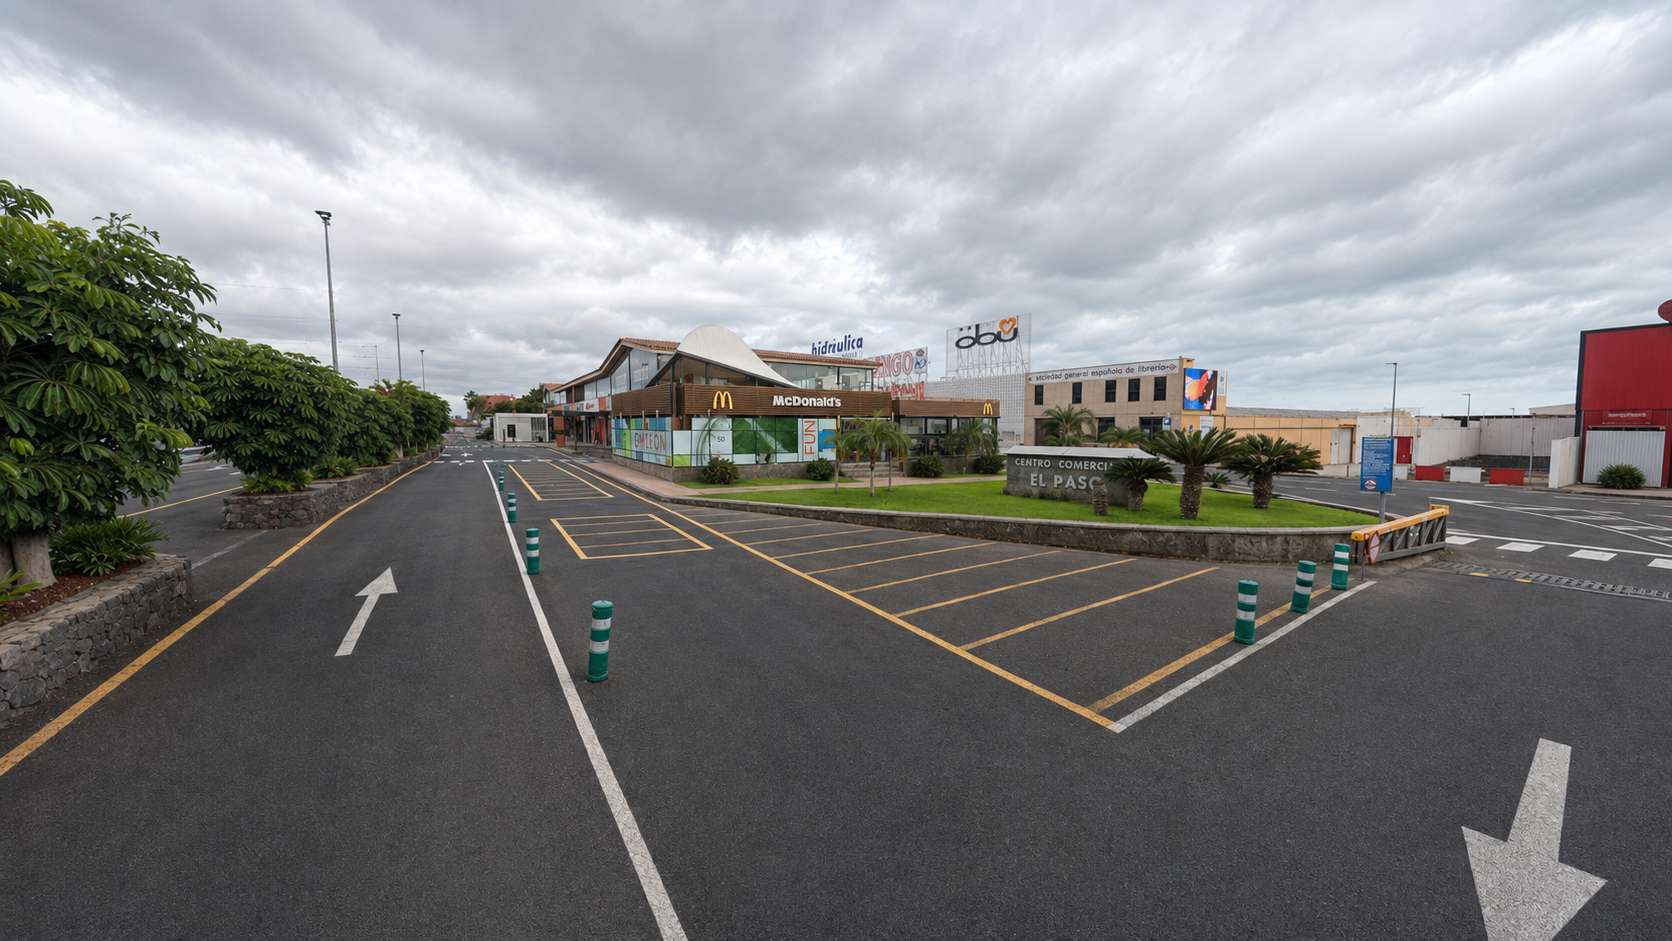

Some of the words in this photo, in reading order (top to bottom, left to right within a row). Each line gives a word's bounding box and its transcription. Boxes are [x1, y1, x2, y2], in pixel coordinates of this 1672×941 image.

[1125, 366, 1135, 374] de
[773, 395, 841, 407] McDonald's
[804, 420, 815, 455] FUN
[1015, 458, 1051, 468] CENTRO
[1030, 473, 1046, 487] EL
